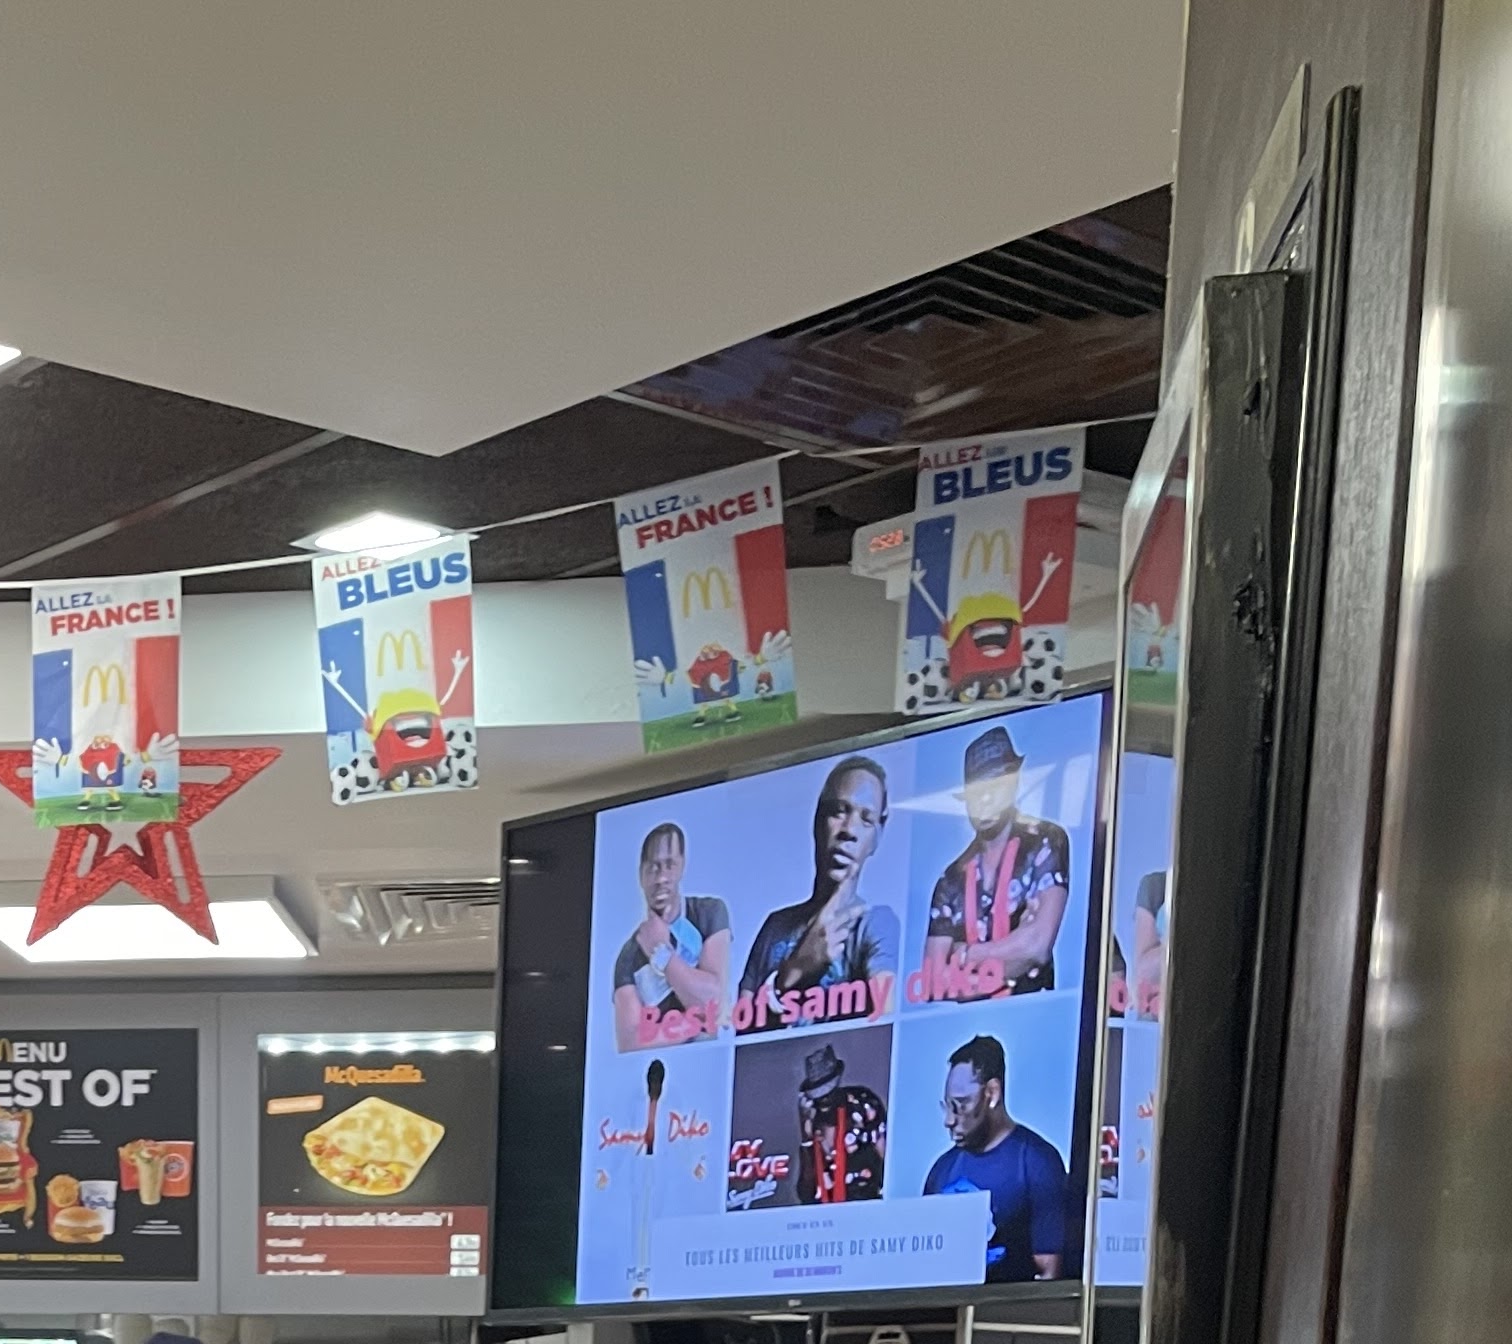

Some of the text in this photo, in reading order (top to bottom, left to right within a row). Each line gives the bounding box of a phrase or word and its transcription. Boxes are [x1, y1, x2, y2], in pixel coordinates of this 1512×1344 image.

[918, 444, 983, 471] ALLEZ
[934, 447, 1072, 505] BLEUS
[618, 495, 682, 529] ALLEZ
[635, 491, 758, 549] FRANCE
[321, 556, 382, 581] ALLEZ
[337, 552, 469, 611] BLEUS
[35, 591, 94, 614] ALLEZ
[50, 599, 161, 636] FRANCE
[782, 975, 894, 1024] samy
[82, 1069, 150, 1107] OF
[686, 1234, 944, 1266] TOUS LES MEILLEURS HITS DE SAMY DIKO
